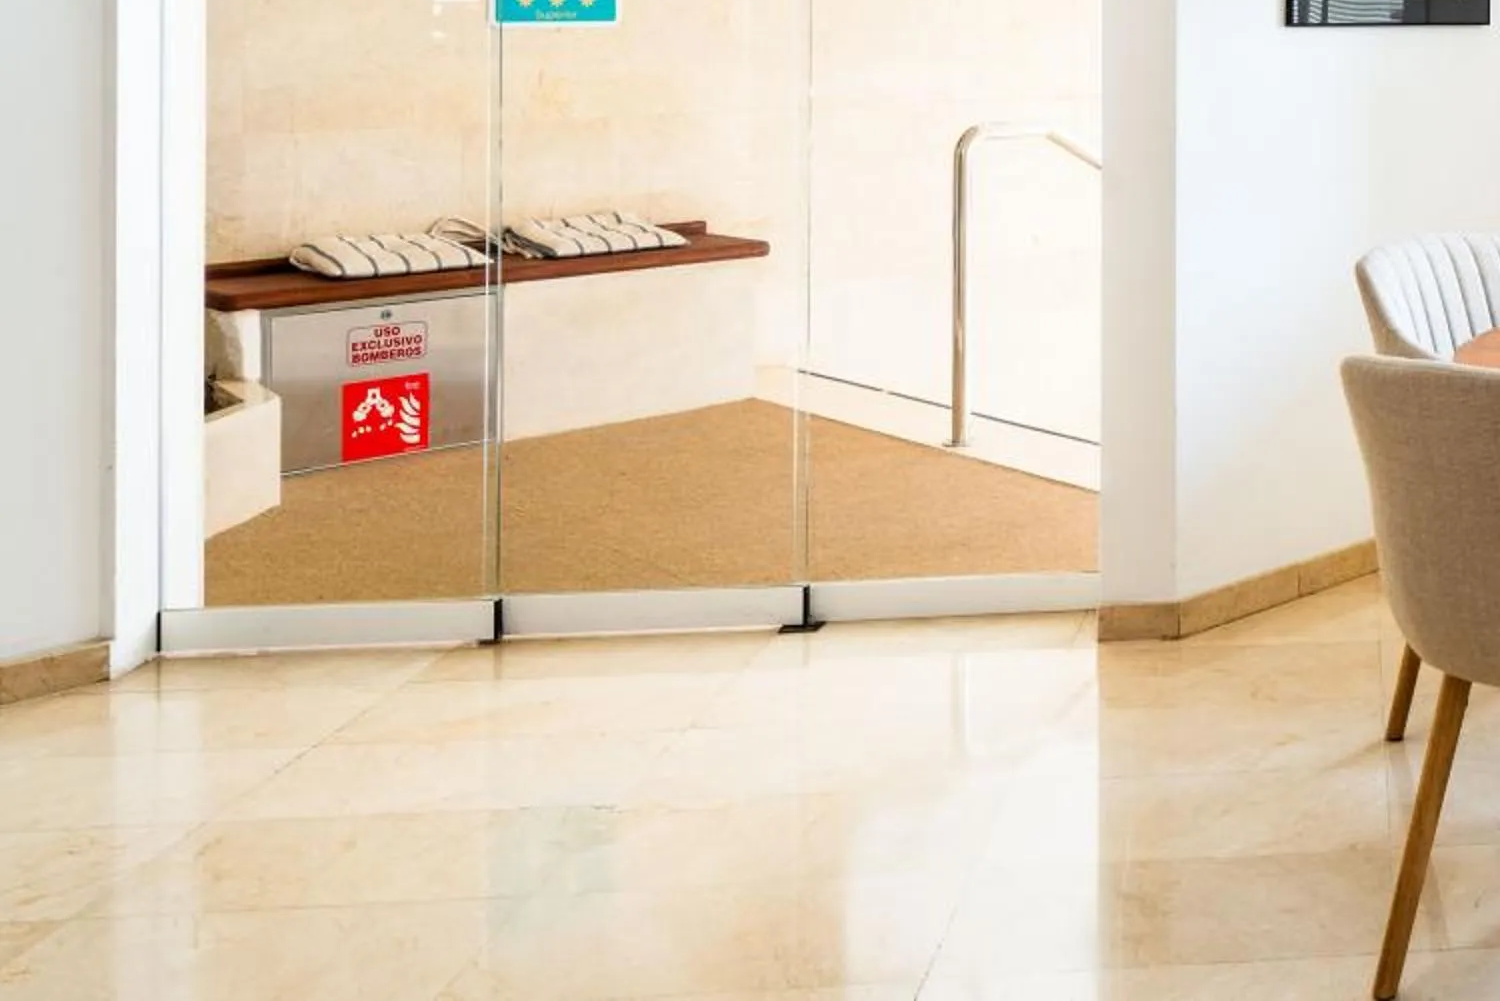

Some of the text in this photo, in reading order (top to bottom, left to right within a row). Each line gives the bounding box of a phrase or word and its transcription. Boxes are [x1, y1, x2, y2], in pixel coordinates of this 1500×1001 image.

[374, 326, 401, 338] USO
[351, 334, 423, 352] EXCLUSIVO
[351, 346, 422, 364] BOMBEROS
